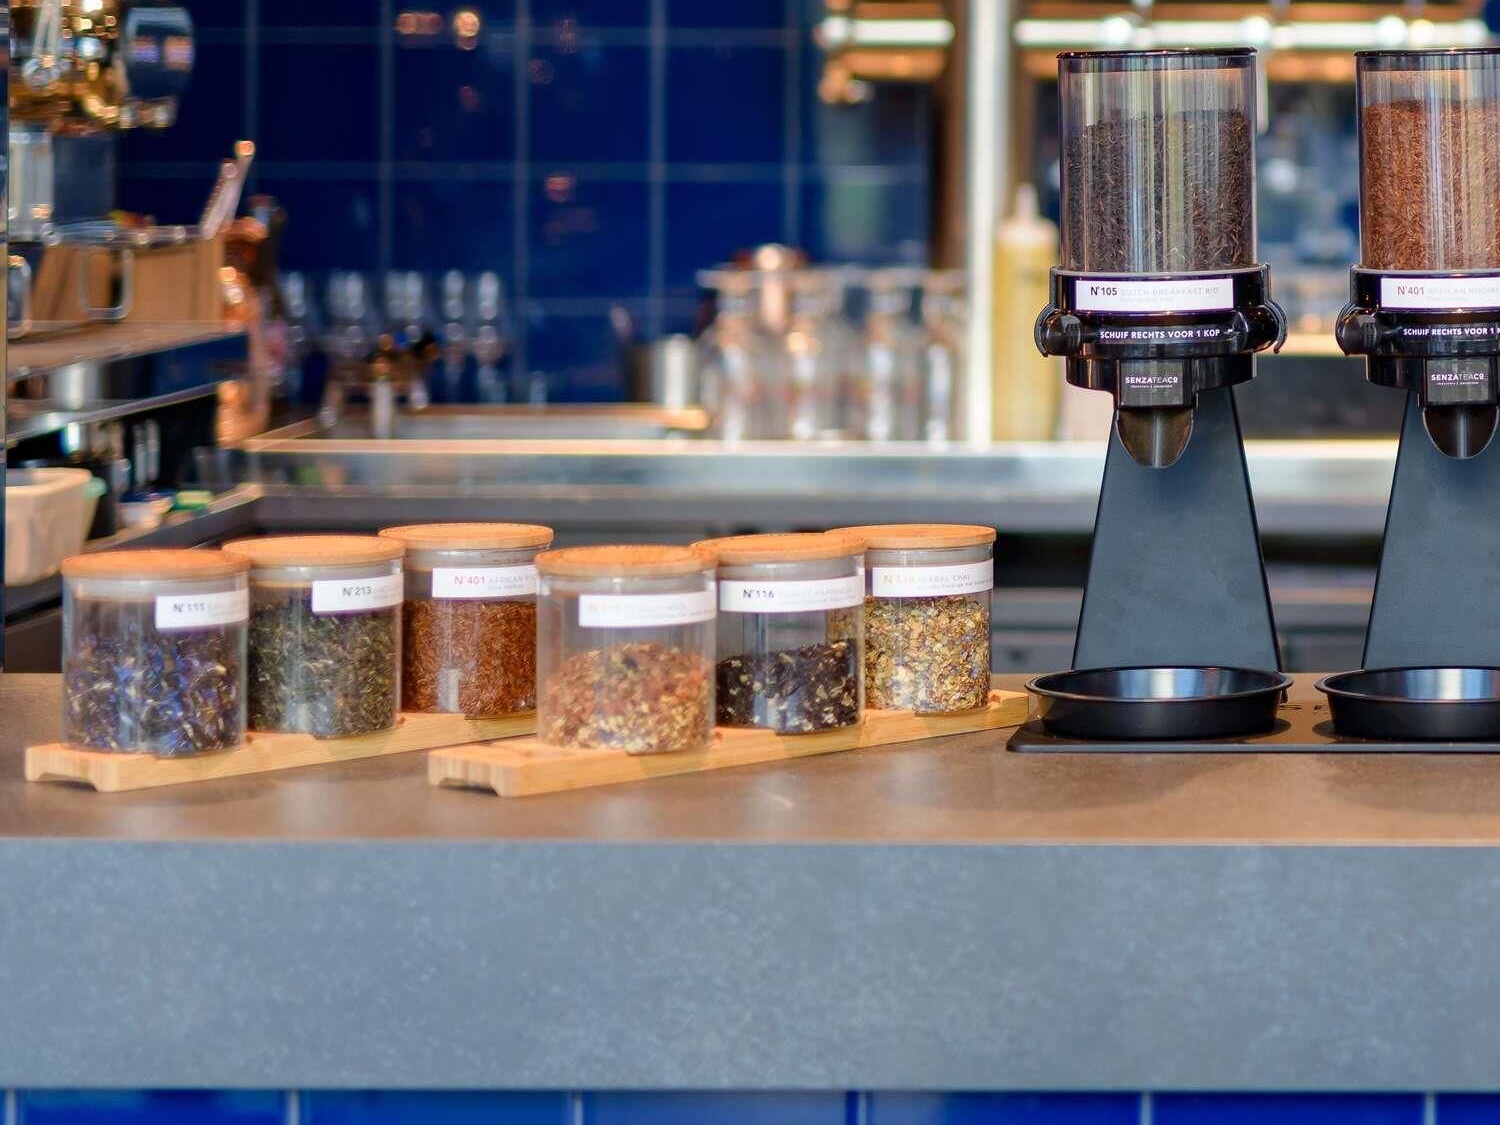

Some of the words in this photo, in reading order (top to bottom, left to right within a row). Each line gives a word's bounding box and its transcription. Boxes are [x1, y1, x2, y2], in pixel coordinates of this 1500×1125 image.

[1100, 331, 1129, 339] SCHUIF
[1131, 330, 1165, 339] RECHTS
[1168, 330, 1194, 339] VOOR
[1203, 329, 1220, 337] KOP
[1402, 328, 1430, 336] SCHUIF
[1431, 328, 1462, 336] RECHTS
[1464, 327, 1488, 335] VOOR
